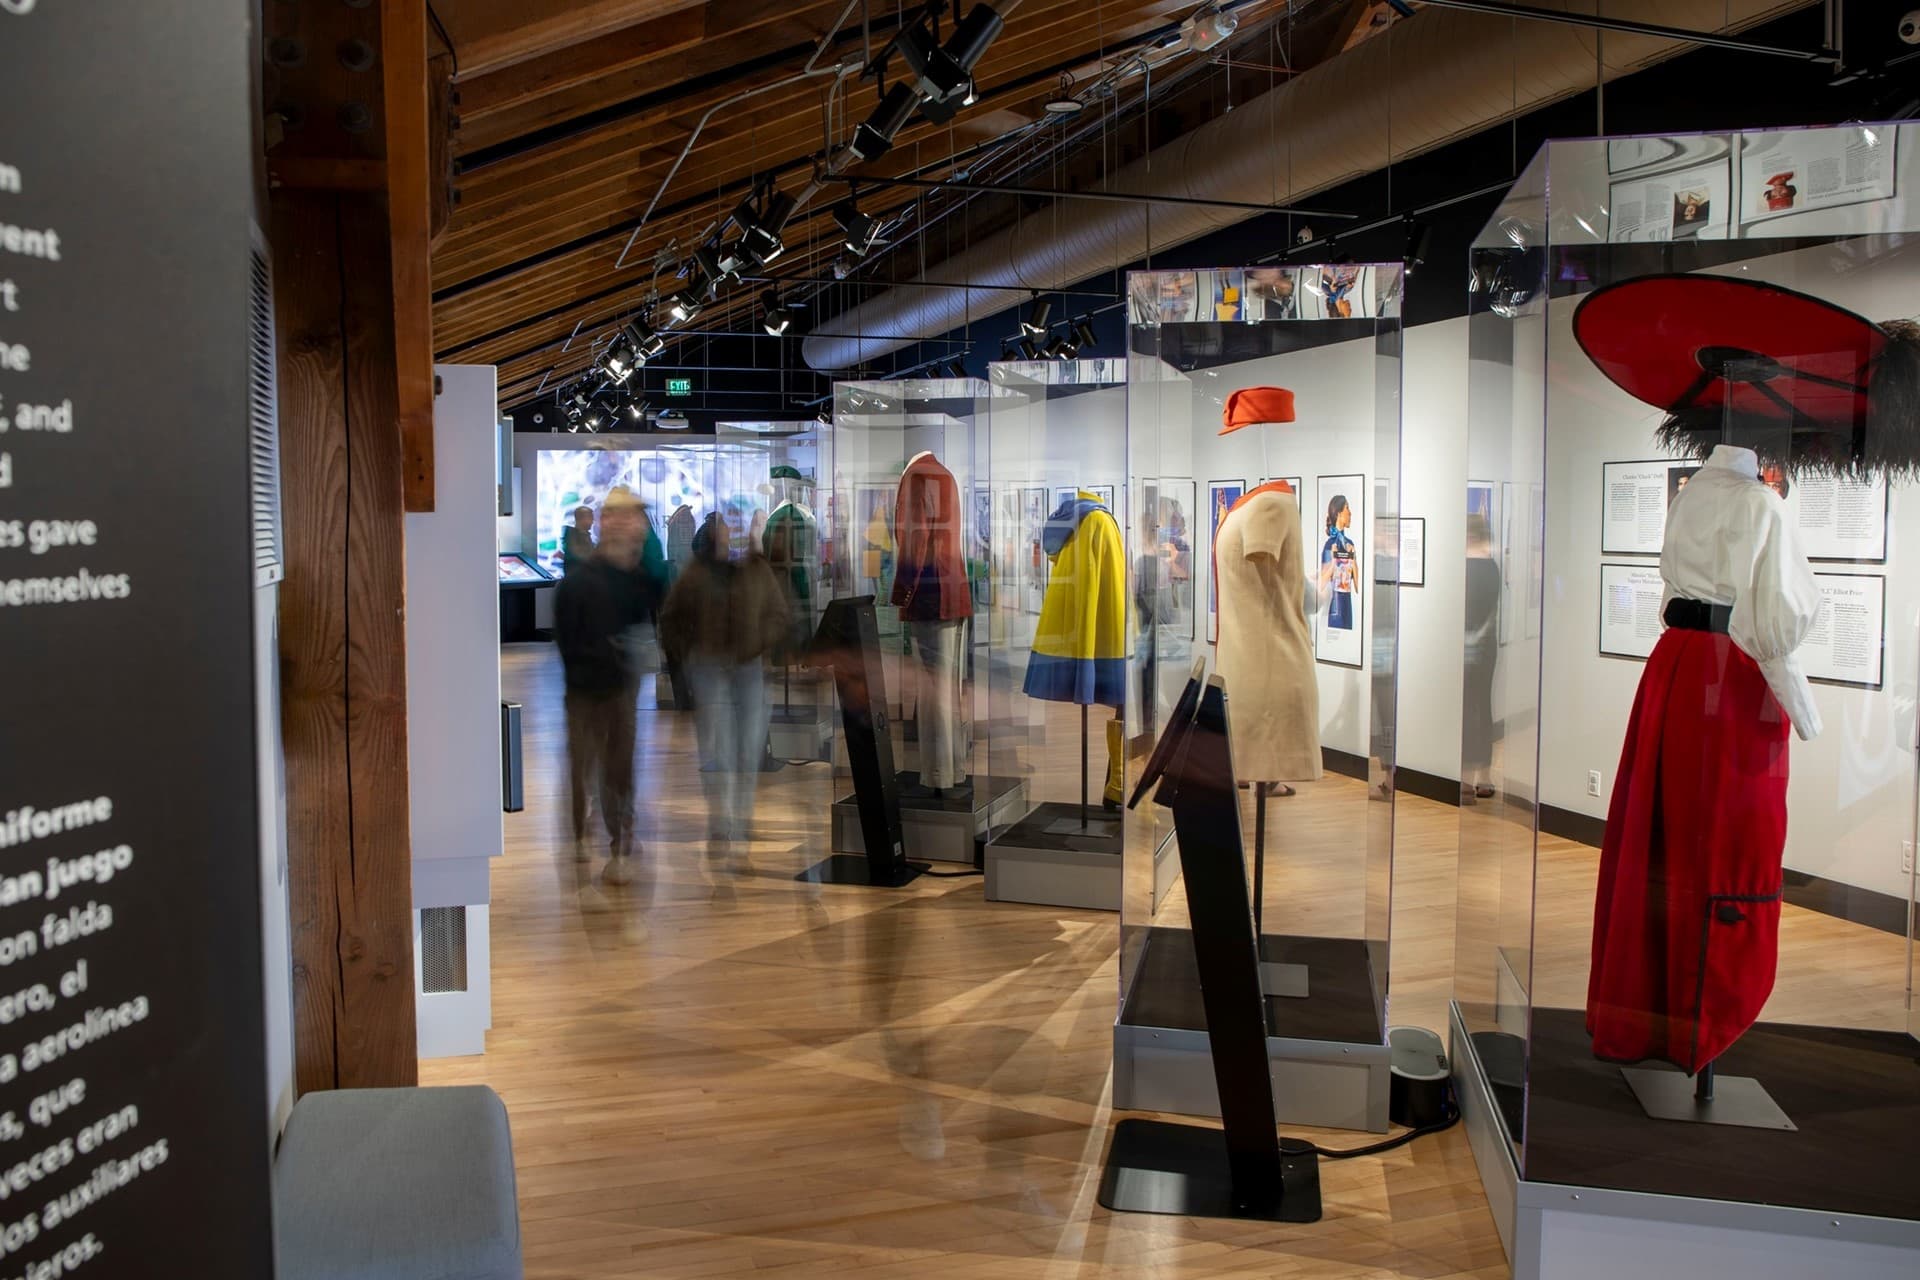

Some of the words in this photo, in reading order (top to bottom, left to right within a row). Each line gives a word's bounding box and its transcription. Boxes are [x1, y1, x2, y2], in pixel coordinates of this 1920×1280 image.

[670, 380, 688, 394] EXIT
[15, 399, 73, 433] and
[28, 519, 97, 555] gave
[0, 870, 42, 906] an
[45, 843, 133, 900] juego
[41, 902, 113, 948] falda
[60, 959, 88, 997] el
[29, 1078, 86, 1127] que
[77, 1104, 138, 1153] eran
[42, 1138, 169, 1229] auxiliares
